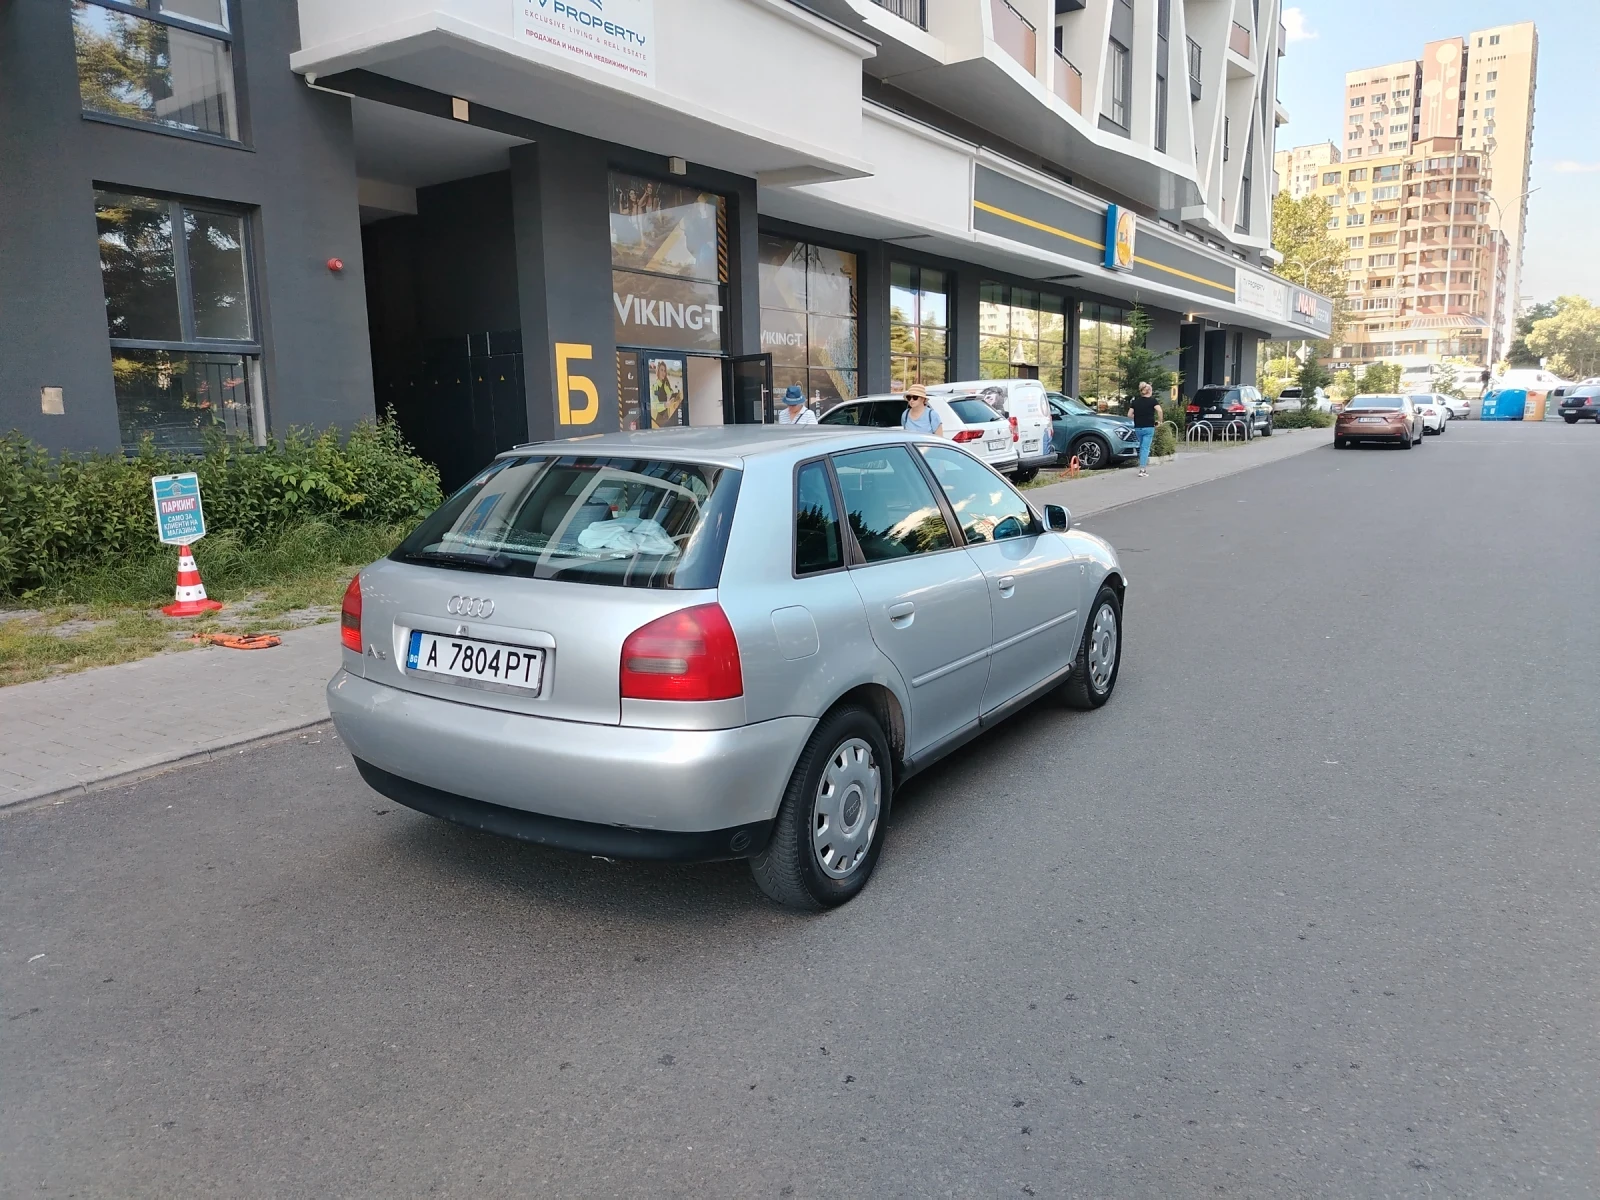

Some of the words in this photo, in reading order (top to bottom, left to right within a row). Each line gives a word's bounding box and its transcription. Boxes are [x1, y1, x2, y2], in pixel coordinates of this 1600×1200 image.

[525, 9, 565, 30] EXCLUSIVE
[569, 26, 593, 41] LIVING
[603, 39, 620, 51] REAL
[623, 46, 647, 61] ESTATE
[529, 0, 547, 8] V
[554, 0, 646, 47] PROPERTY
[525, 28, 561, 47] ПРОДАЖБА
[562, 41, 567, 49] И
[567, 44, 584, 55] НАЕМ
[585, 50, 593, 58] НА
[593, 53, 629, 72] НЕДВИЖИМИ
[629, 66, 648, 78] ИМОТИ
[613, 291, 724, 335] VIKING-T
[1298, 292, 1317, 318] NANI
[555, 342, 599, 425] Б
[162, 497, 195, 513] ПАРКИНГ
[167, 514, 184, 523] САМО
[164, 520, 190, 530] КЛИЕНТИ
[167, 526, 197, 536] МАГАЗИНА
[409, 655, 418, 664] BG
[426, 639, 438, 668] A
